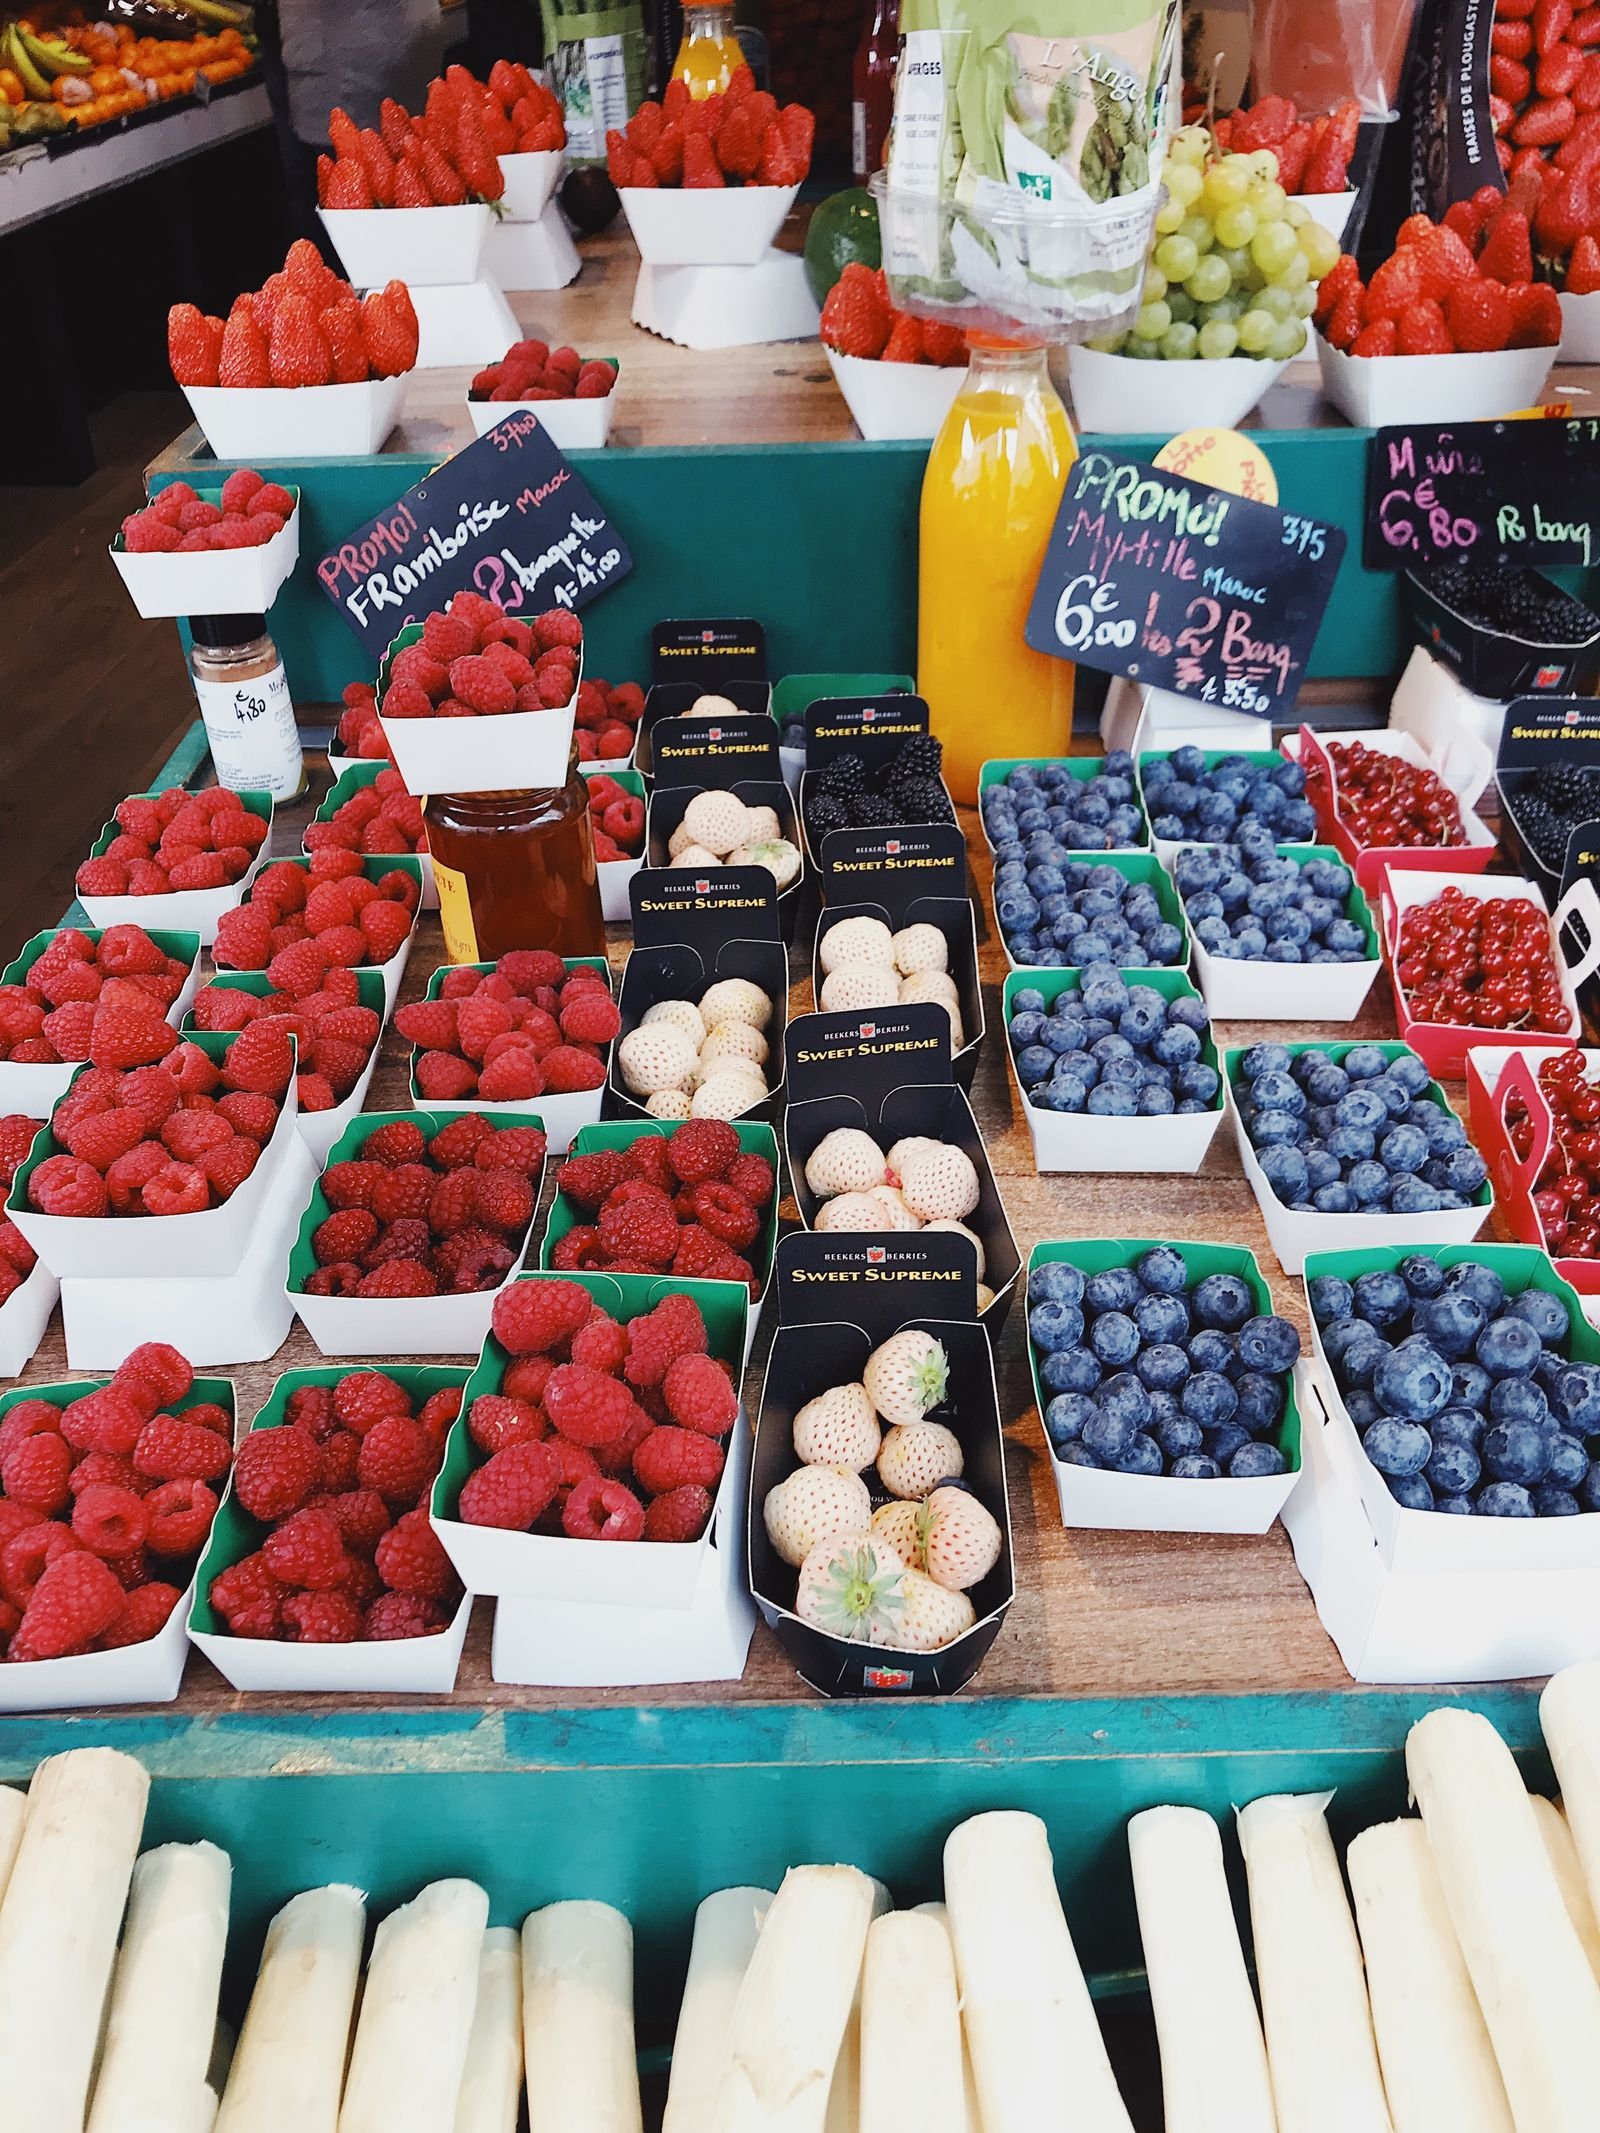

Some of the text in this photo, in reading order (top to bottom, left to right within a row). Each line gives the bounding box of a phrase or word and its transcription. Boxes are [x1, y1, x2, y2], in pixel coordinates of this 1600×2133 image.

[1461, 85, 1474, 105] DE
[1462, 108, 1482, 164] FRAISES
[1175, 596, 1222, 657] 2
[659, 645, 757, 656] SWEET SUPREME
[815, 723, 922, 738] SWEET SUPREME
[1510, 726, 1600, 739] SWEET SUPR
[661, 743, 770, 757] SWEET SUPREME
[855, 843, 930, 854] BEEKERS BERRIES
[832, 856, 955, 873] SWEET SUPREME
[664, 883, 741, 893] BEEKERS BERRIES
[640, 898, 767, 912] SWEET SUPREME
[824, 1024, 910, 1040] BEEKERS BERRIES
[797, 1038, 939, 1063] SWEET SUPREME
[824, 1252, 928, 1261] BEEKERS BERRIES
[791, 1268, 962, 1282] SWEET SUPREME
